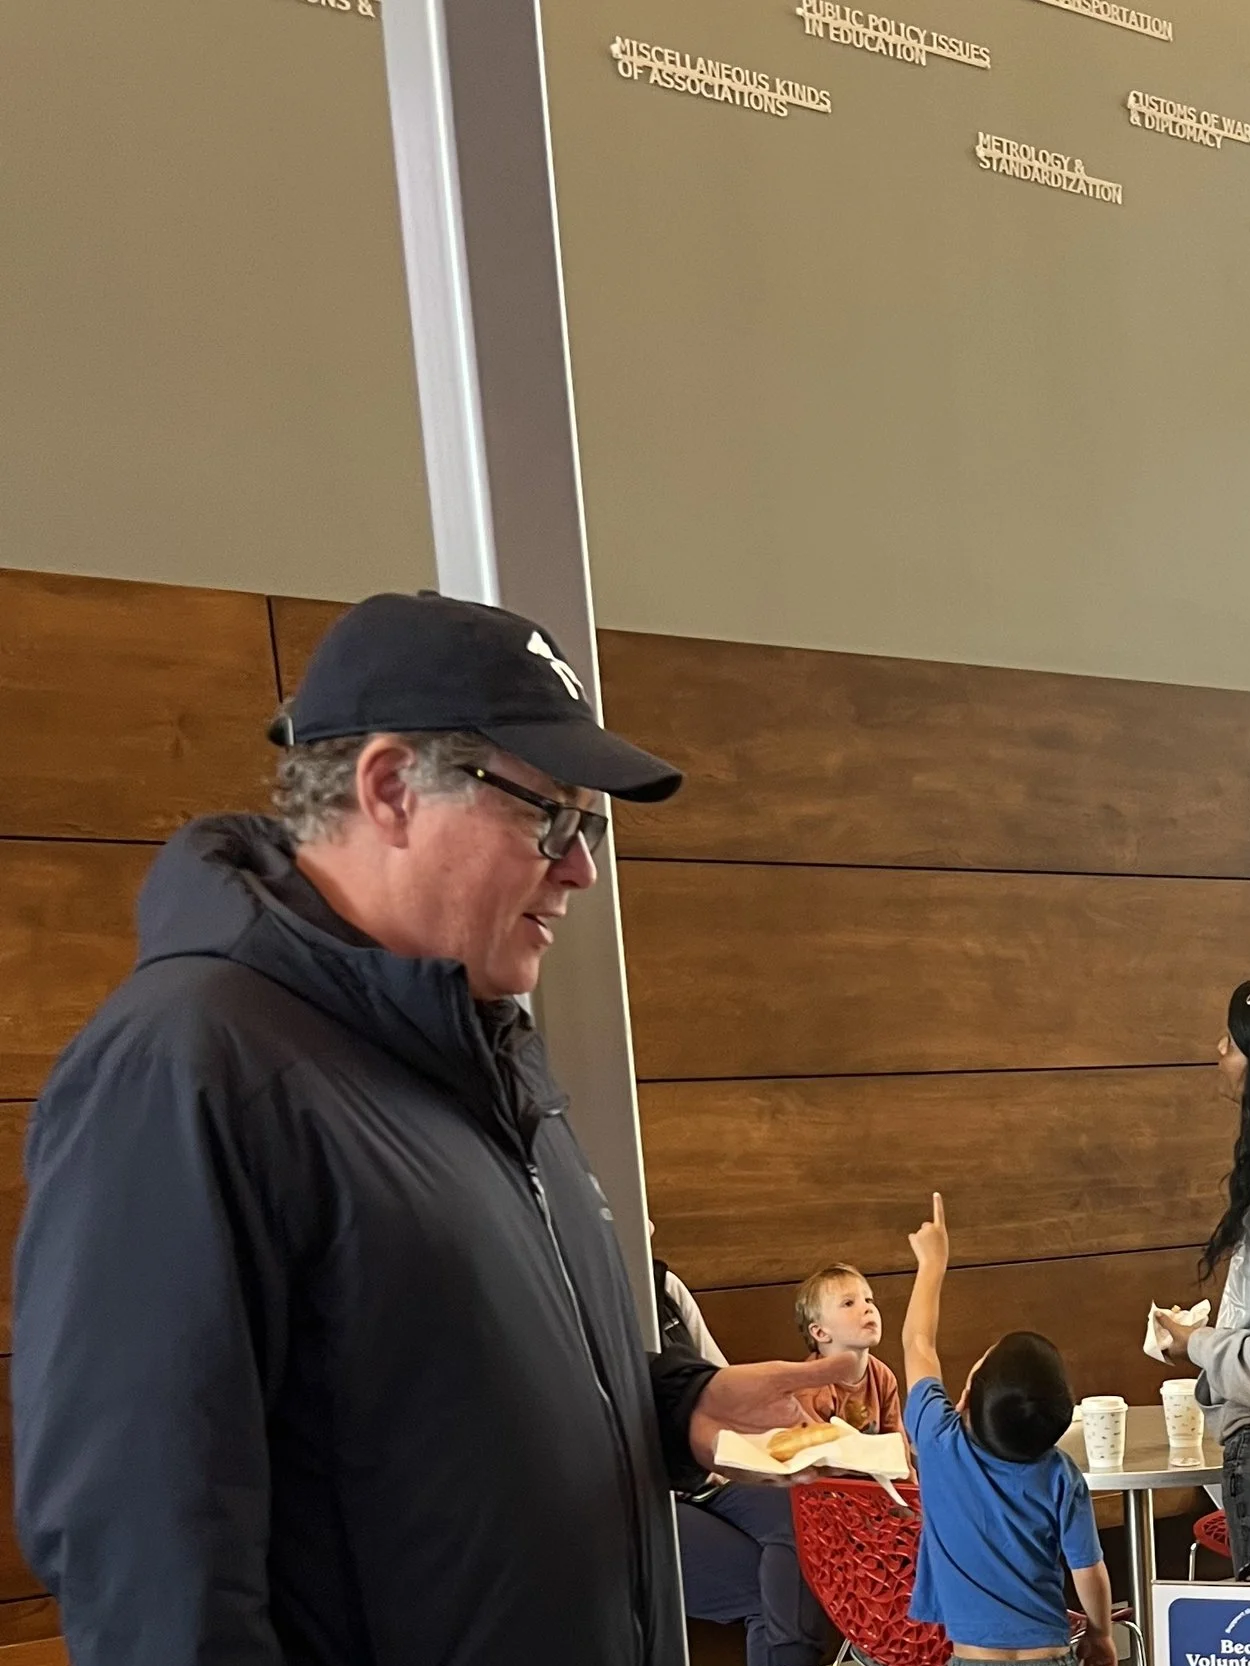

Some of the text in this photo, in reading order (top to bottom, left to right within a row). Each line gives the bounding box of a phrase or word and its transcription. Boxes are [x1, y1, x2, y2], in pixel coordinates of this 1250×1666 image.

[802, 0, 990, 64] PUBLIC POLICY ISSUES
[805, 18, 927, 66] IN EDUCATION
[616, 36, 831, 108] MISCELLANEOUS KINDS
[618, 60, 788, 117] OF ASSOCIATIONS
[1128, 90, 1197, 124] CUSTOMS
[1200, 111, 1219, 131] OF
[1130, 108, 1223, 149] & DIPLOMACY
[978, 132, 1086, 177] METROLOGY &
[979, 154, 1122, 204] STANDARDIZATION
